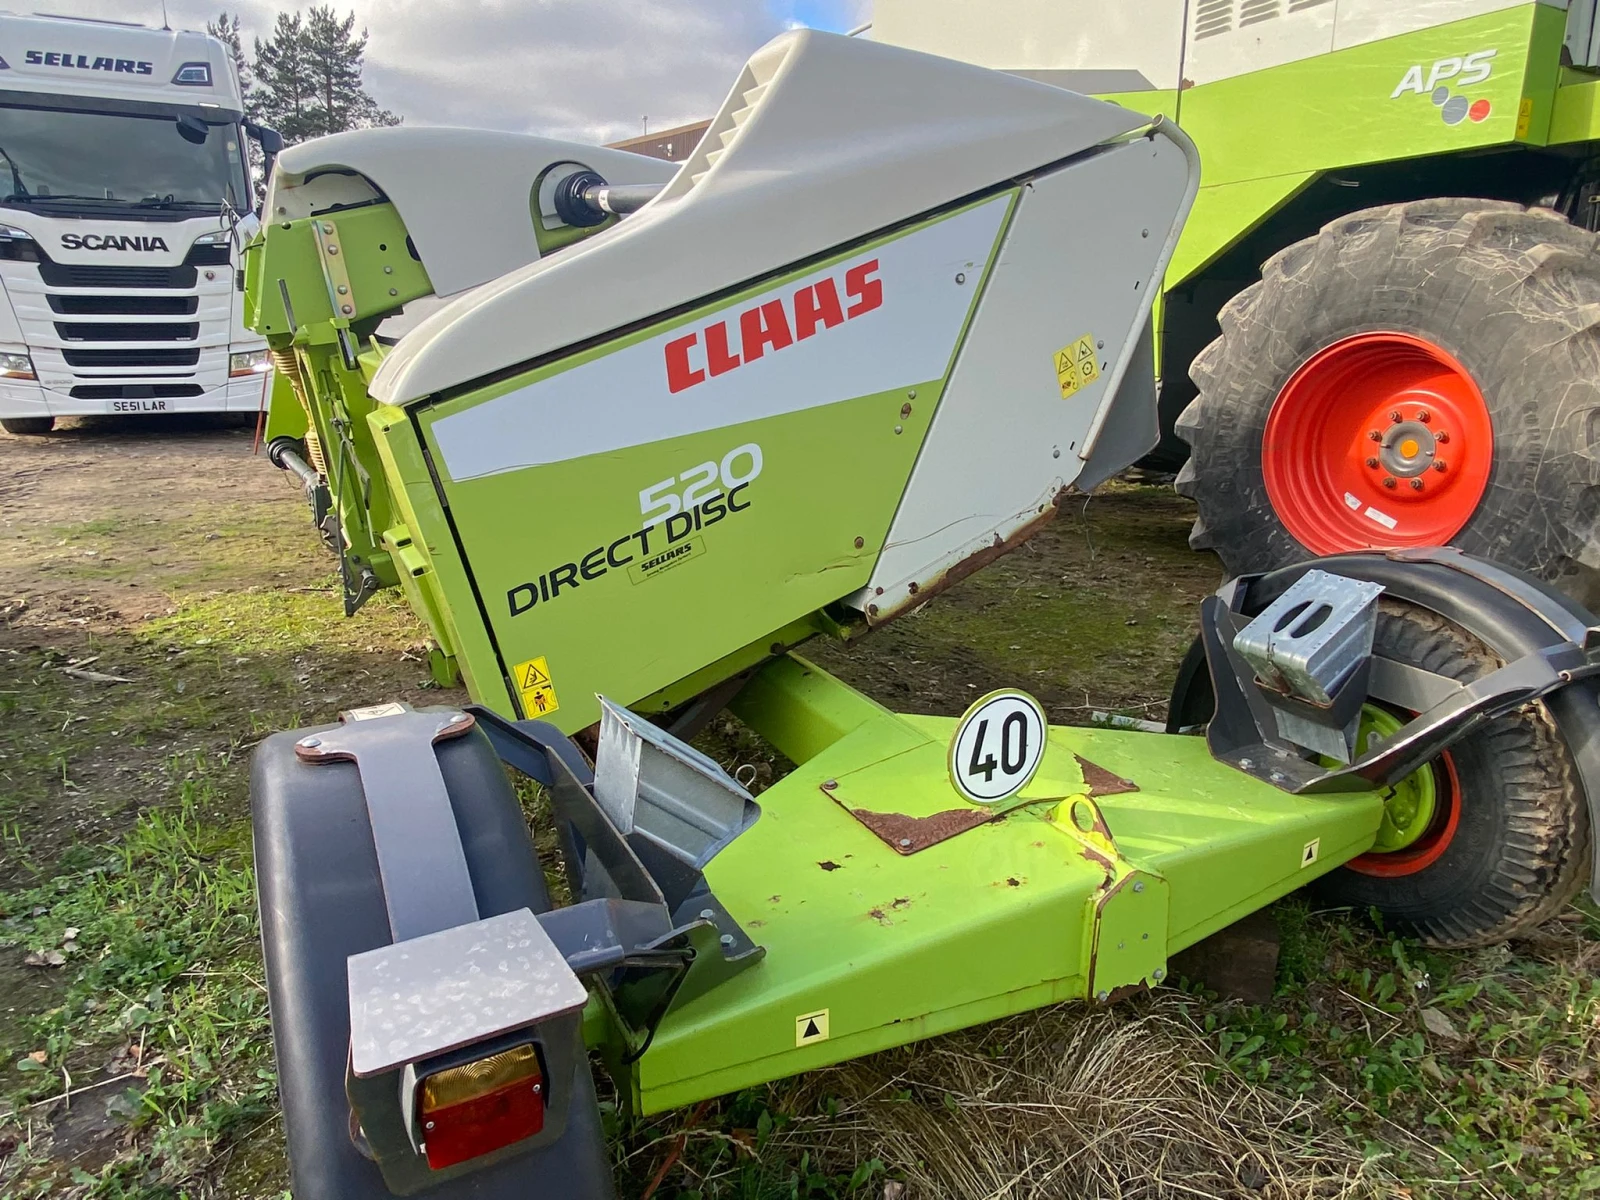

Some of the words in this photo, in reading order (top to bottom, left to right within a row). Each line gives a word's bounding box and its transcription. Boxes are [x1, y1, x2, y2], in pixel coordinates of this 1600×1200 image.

[25, 50, 152, 75] SELLARS
[1390, 49, 1498, 99] APS
[61, 233, 170, 252] SCANIA
[664, 258, 883, 394] CLAAS
[113, 401, 141, 412] SE51
[143, 401, 166, 411] LAR
[639, 442, 763, 529] 520
[507, 525, 655, 617] DIRECT
[665, 481, 751, 544] DISC
[641, 542, 692, 573] SELLARS
[968, 710, 1028, 782] 40
